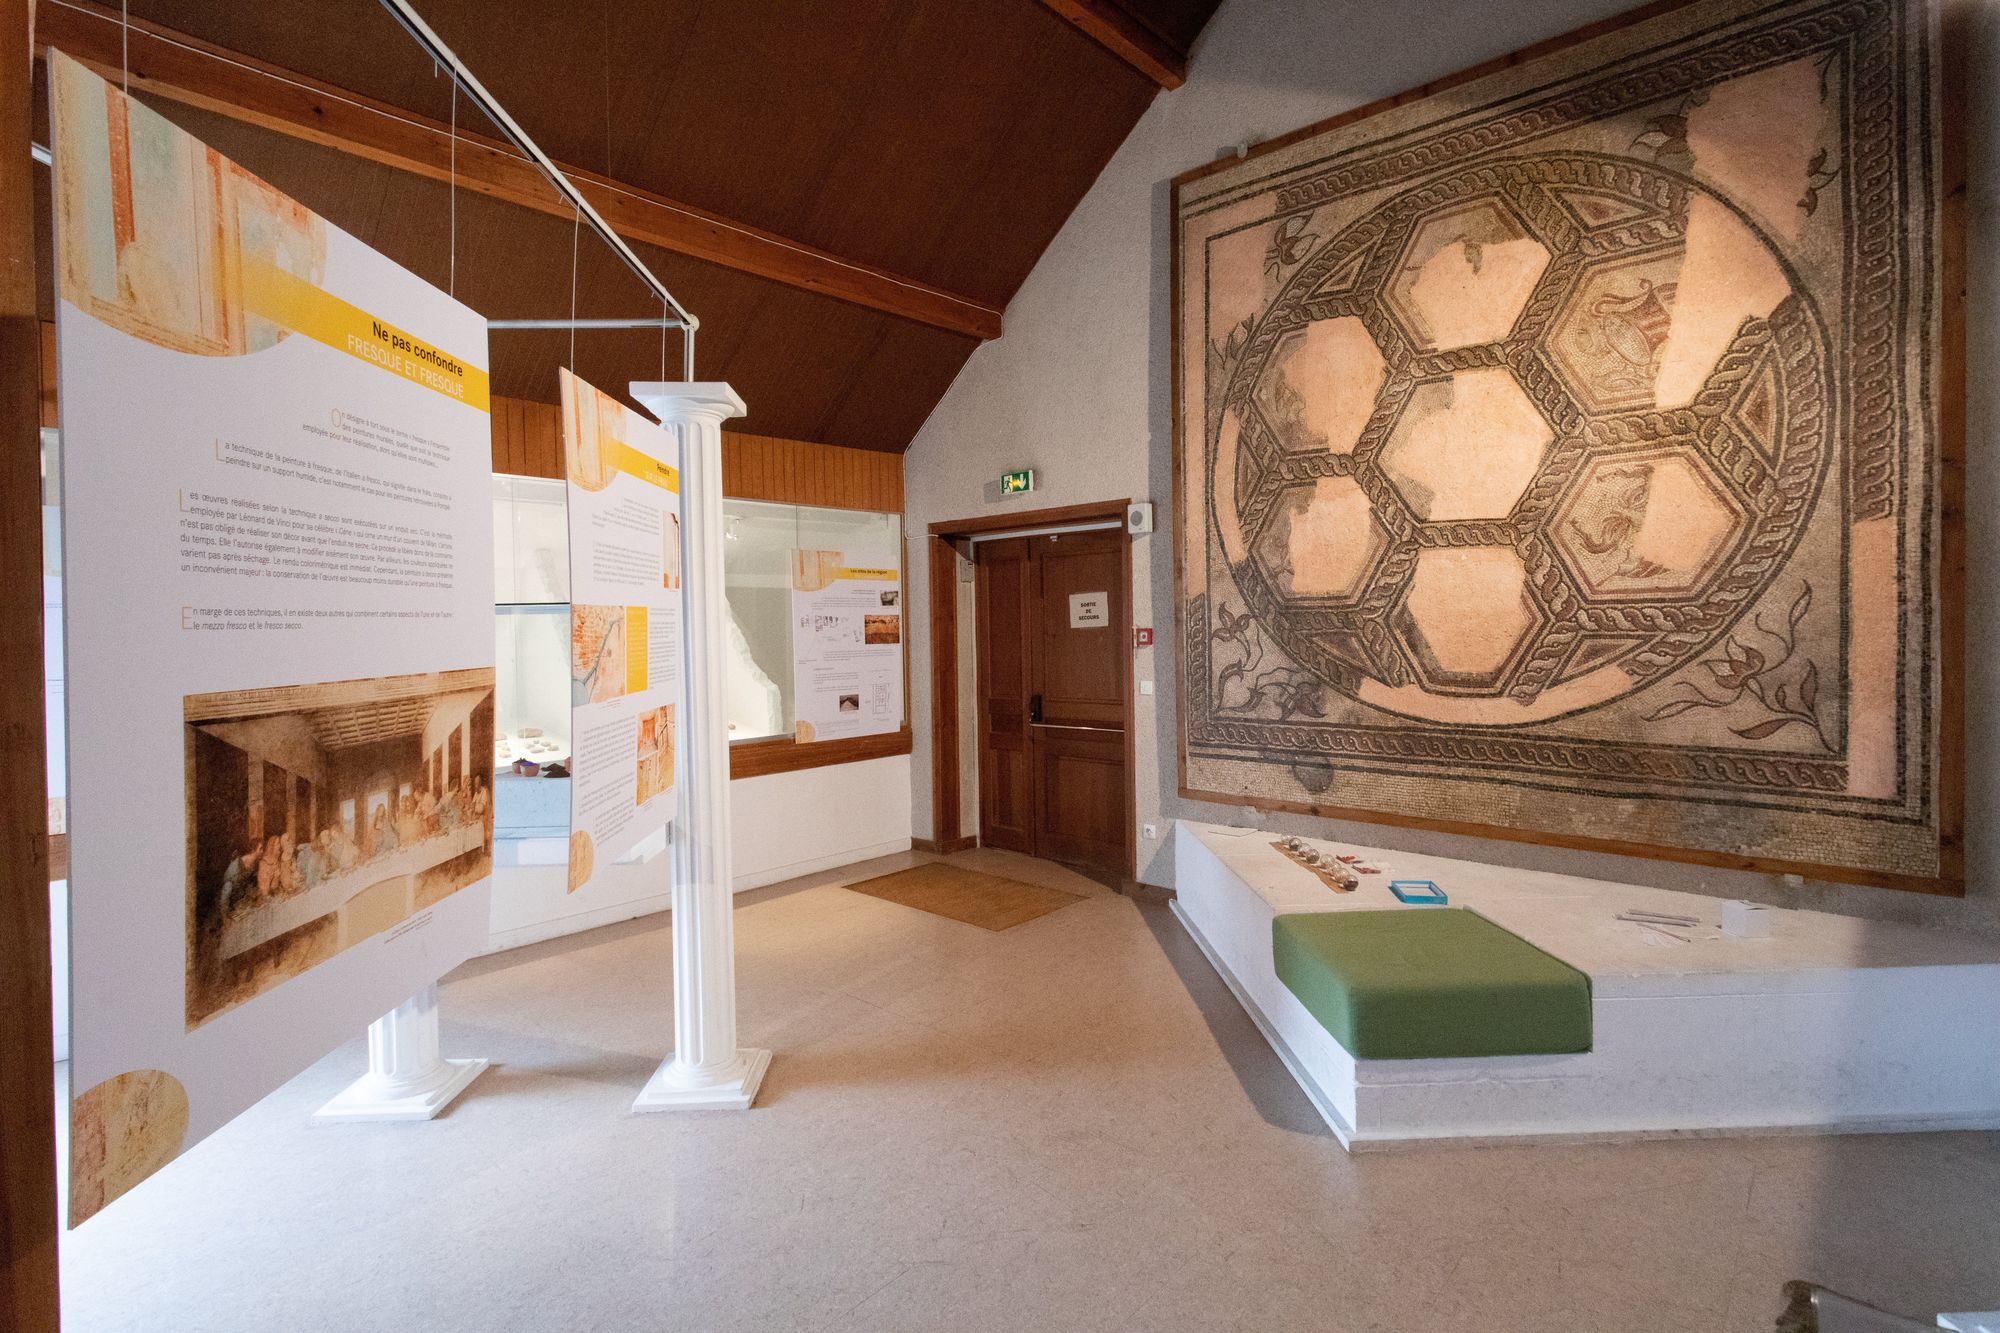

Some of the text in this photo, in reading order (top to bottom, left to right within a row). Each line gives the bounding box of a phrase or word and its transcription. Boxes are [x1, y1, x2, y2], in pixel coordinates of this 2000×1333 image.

[373, 321, 463, 377] Ne pas confondre
[348, 334, 464, 399] FRESQUE ET FRESQUE
[303, 425, 328, 437] employée
[231, 443, 264, 458] technique
[265, 451, 273, 460] de
[275, 453, 281, 461] la
[282, 456, 306, 467] peinture
[225, 457, 250, 468] peindre
[272, 468, 295, 477] support
[202, 495, 228, 505] œuvres
[231, 499, 260, 510] réalisées
[262, 504, 279, 513] selon
[289, 508, 316, 519] technique
[190, 508, 225, 519] employée
[239, 513, 265, 524] Léonard
[276, 519, 291, 527] Vinci
[180, 520, 199, 529] n'est
[200, 524, 213, 532] pas
[214, 524, 235, 535] obligé
[237, 526, 245, 534] de
[247, 528, 269, 537] réaliser
[283, 532, 300, 541] décor
[180, 534, 190, 542] du
[192, 535, 216, 546] temps.
[219, 538, 231, 547] Elle
[233, 540, 263, 550] l'autorise
[264, 543, 296, 553] également
[180, 550, 206, 558] varient
[223, 553, 242, 562] après
[192, 564, 237, 574] inconvénient
[247, 609, 283, 618] techniques,
